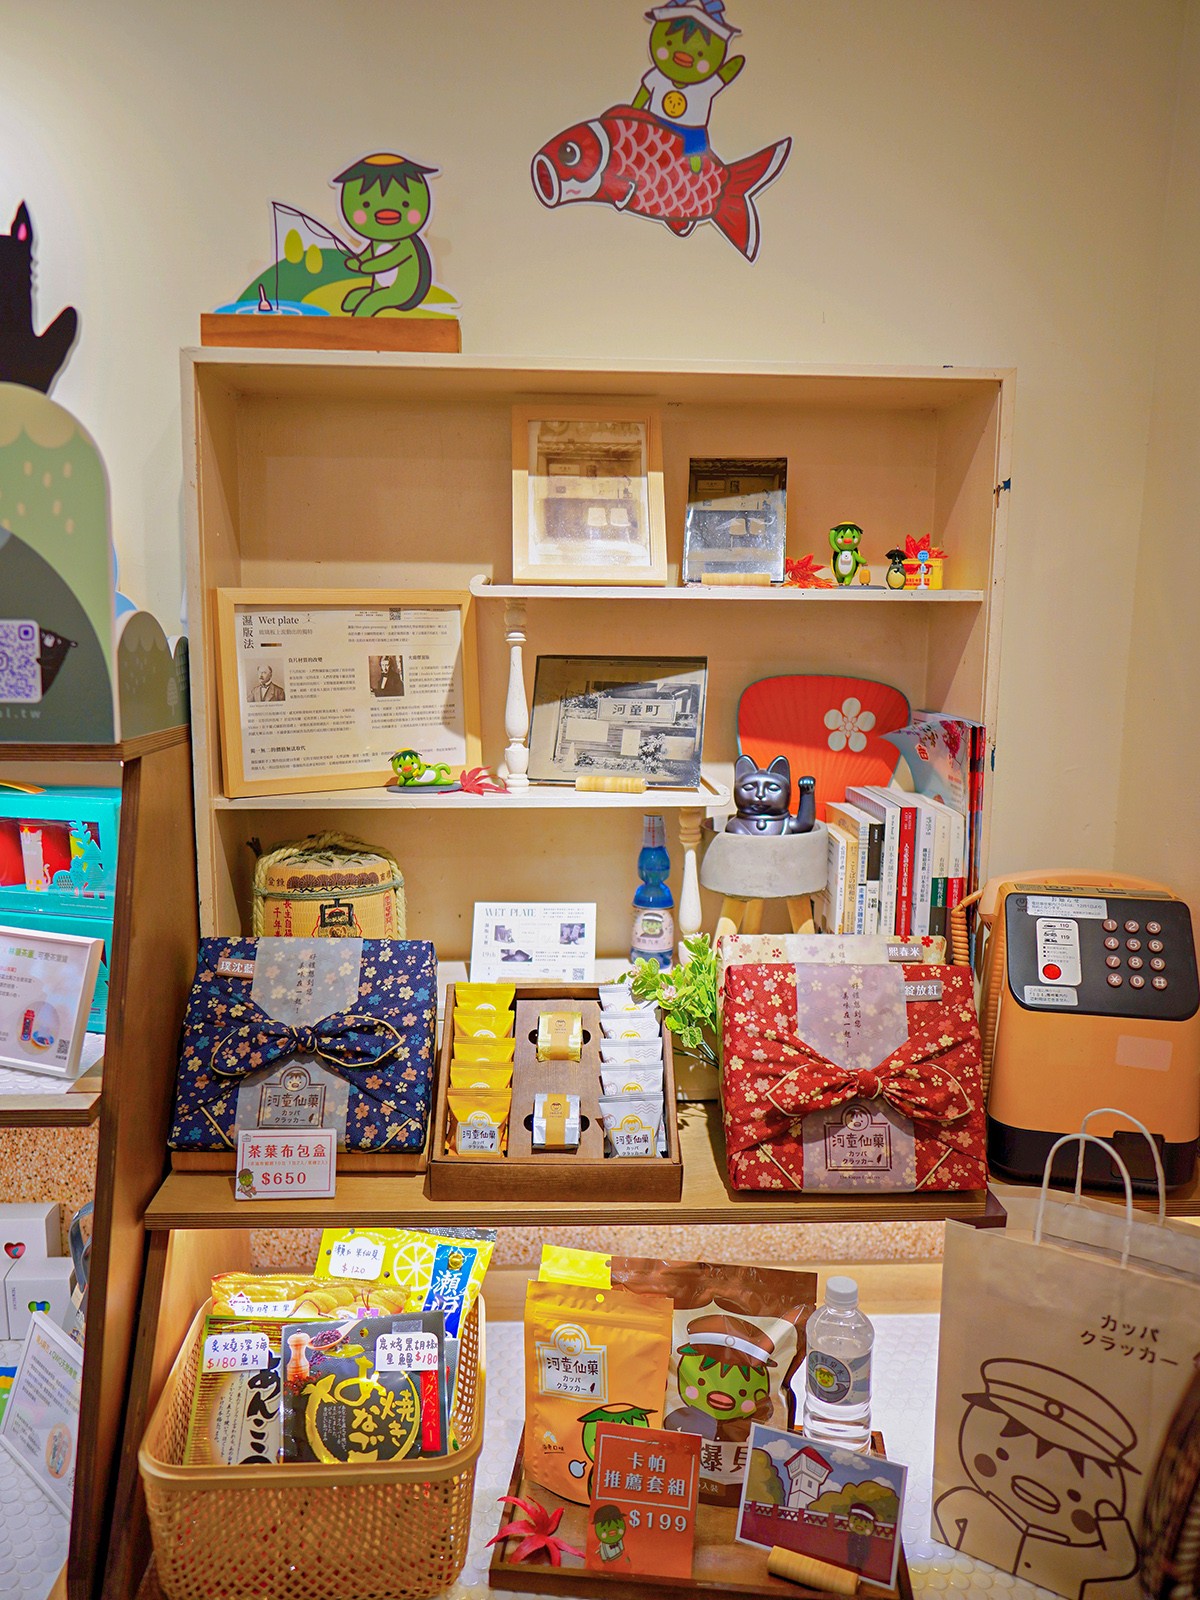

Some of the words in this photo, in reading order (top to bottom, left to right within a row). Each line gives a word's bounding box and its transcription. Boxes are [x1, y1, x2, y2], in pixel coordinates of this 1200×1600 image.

[258, 616, 275, 625] Wet
[278, 616, 299, 626] plate
[612, 703, 661, 716] 河童町
[485, 908, 505, 917] WET
[510, 908, 537, 917] PLATE
[1128, 922, 1136, 930] 2
[1150, 923, 1158, 932] 3
[1108, 939, 1116, 947] 4
[1130, 940, 1138, 948] 5
[1152, 941, 1159, 950] 6
[1110, 957, 1117, 965] 7
[1132, 958, 1140, 966] 8
[1154, 959, 1162, 969] 9
[1133, 977, 1141, 986] 0
[904, 984, 939, 996] 綻放紅
[267, 1093, 319, 1108] 河童仙菓
[832, 1133, 885, 1149] 河童仙菓
[248, 1144, 326, 1159] 茶葉布包盒
[261, 1172, 307, 1185] $650
[1101, 1314, 1159, 1342] カッパ
[1080, 1330, 1179, 1366] クラッカー
[207, 1357, 237, 1369] $180
[415, 1351, 438, 1365] $180
[547, 1356, 599, 1376] 河童仙菓
[562, 1375, 581, 1384] カッパ
[556, 1383, 587, 1393] クラッカー
[626, 1451, 666, 1473] 卡帕
[604, 1469, 686, 1498] 推薦套組
[698, 1482, 719, 1493] 入裝
[628, 1508, 688, 1533] $199
